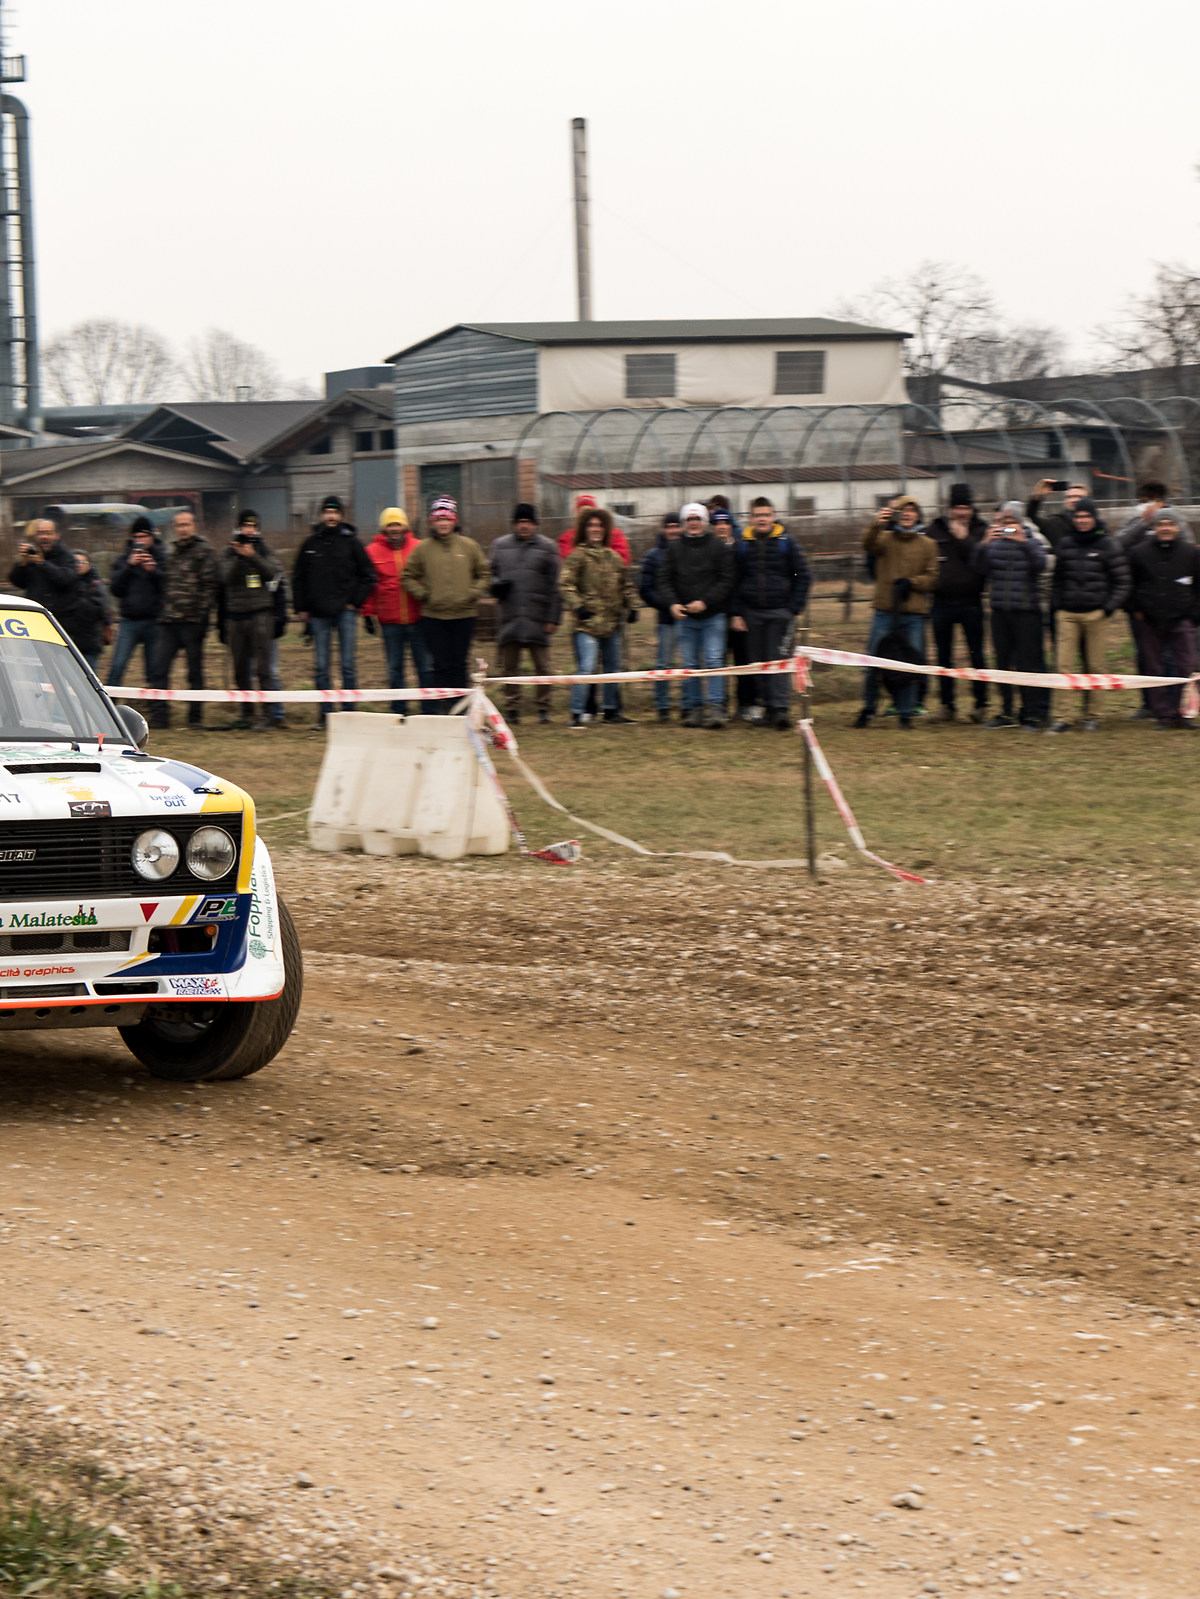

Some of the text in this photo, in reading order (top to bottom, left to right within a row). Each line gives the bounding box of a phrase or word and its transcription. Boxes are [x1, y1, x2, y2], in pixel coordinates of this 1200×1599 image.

[149, 794, 186, 802] break
[164, 799, 188, 808] out
[8, 912, 98, 929] Malatesta
[266, 905, 275, 940] Shipping
[23, 965, 76, 978] graphics
